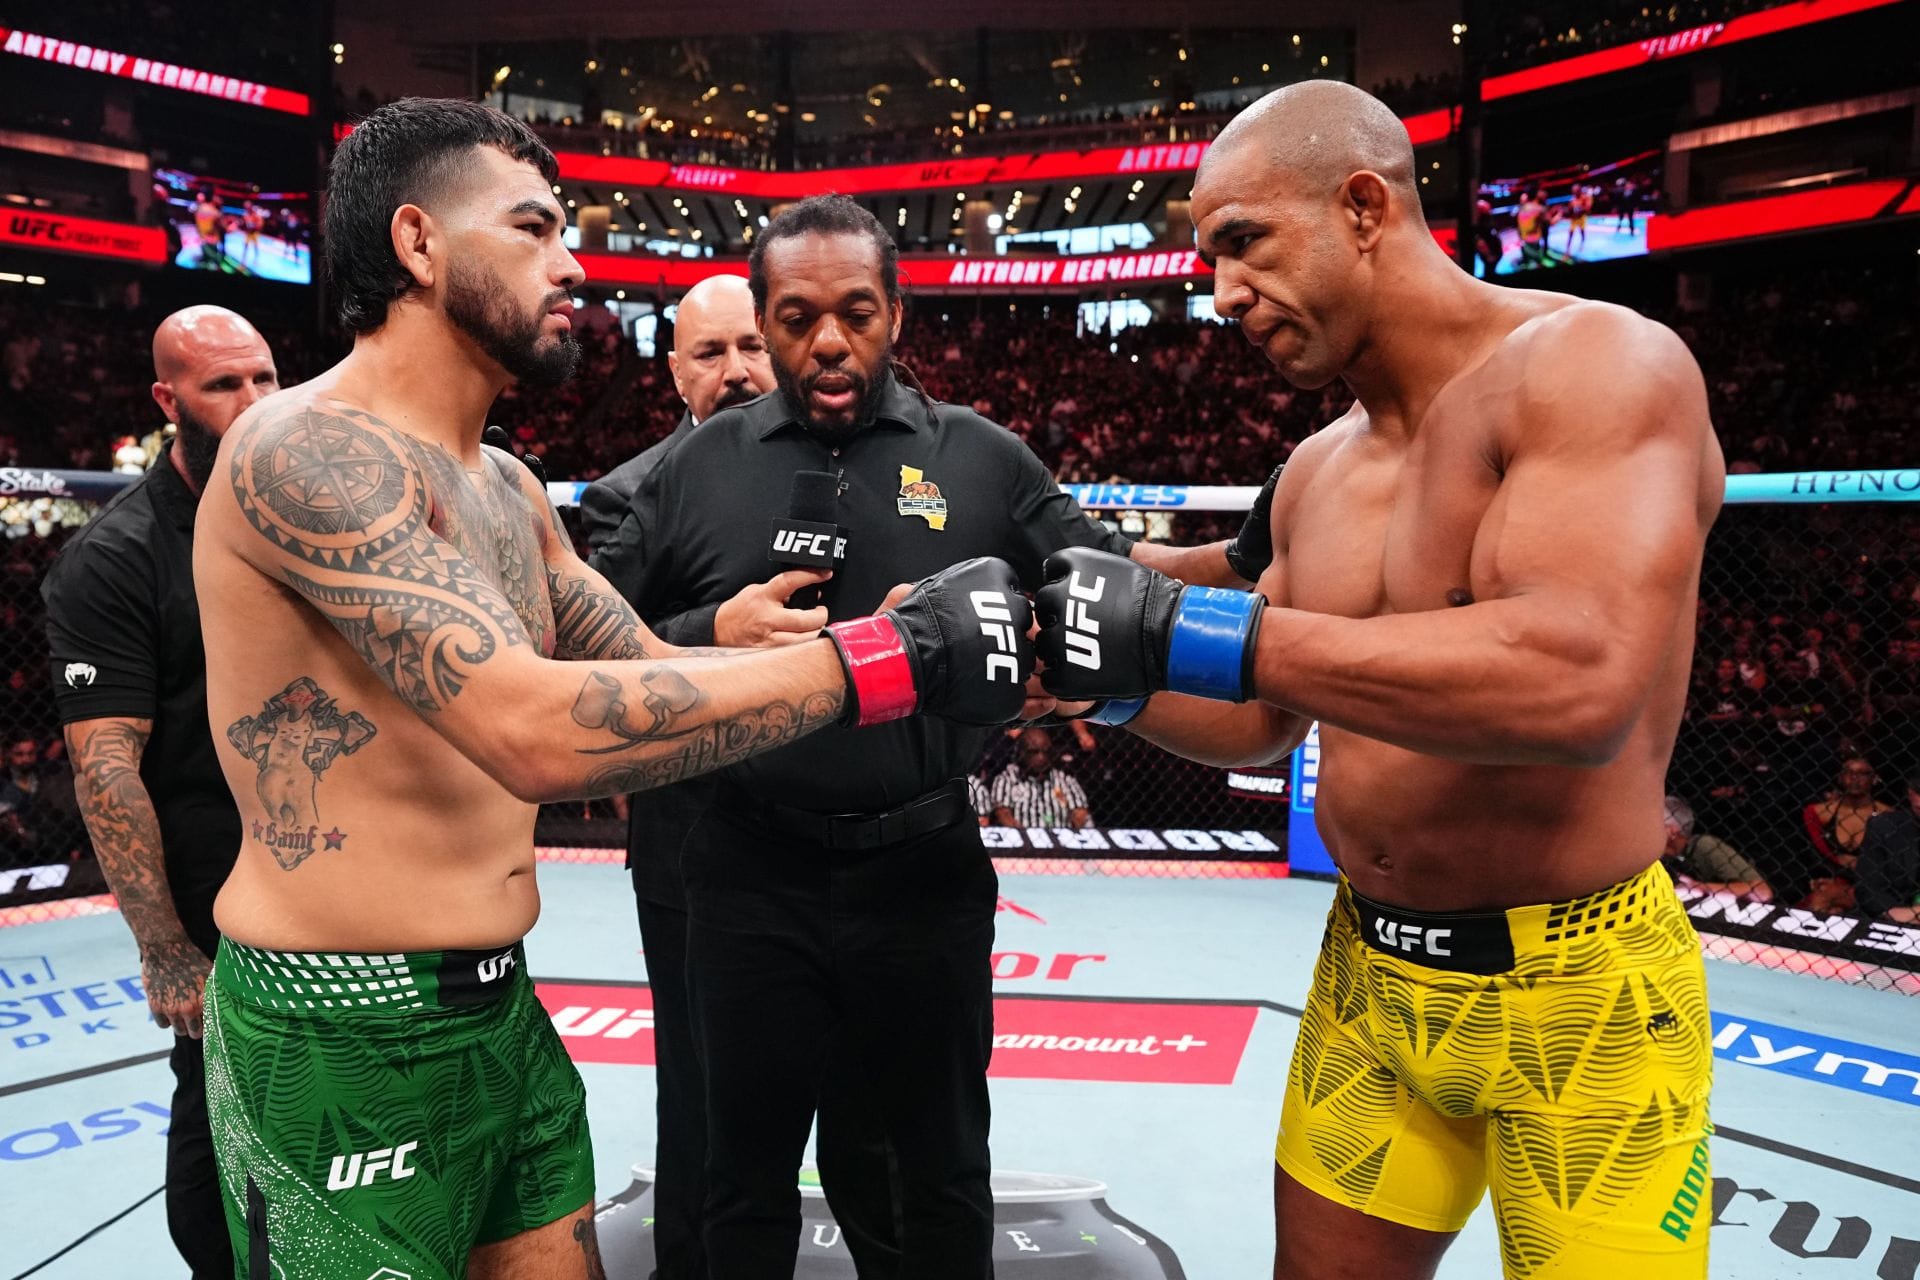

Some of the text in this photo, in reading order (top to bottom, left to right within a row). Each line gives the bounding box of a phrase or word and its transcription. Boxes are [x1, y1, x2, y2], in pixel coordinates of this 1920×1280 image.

[4, 30, 267, 106] ANTHONY HERNANDEZ
[10, 216, 65, 241] UFC
[949, 250, 1199, 283] ANTHONY HERNANDEZ
[0, 467, 66, 496] Stake
[1064, 484, 1188, 506] TIRES
[900, 500, 946, 511] CSAC
[773, 529, 832, 556] UFC
[970, 590, 1019, 684] UFC
[1065, 570, 1106, 671] UFC
[1375, 917, 1452, 957] UFC
[327, 1140, 418, 1191] UFC
